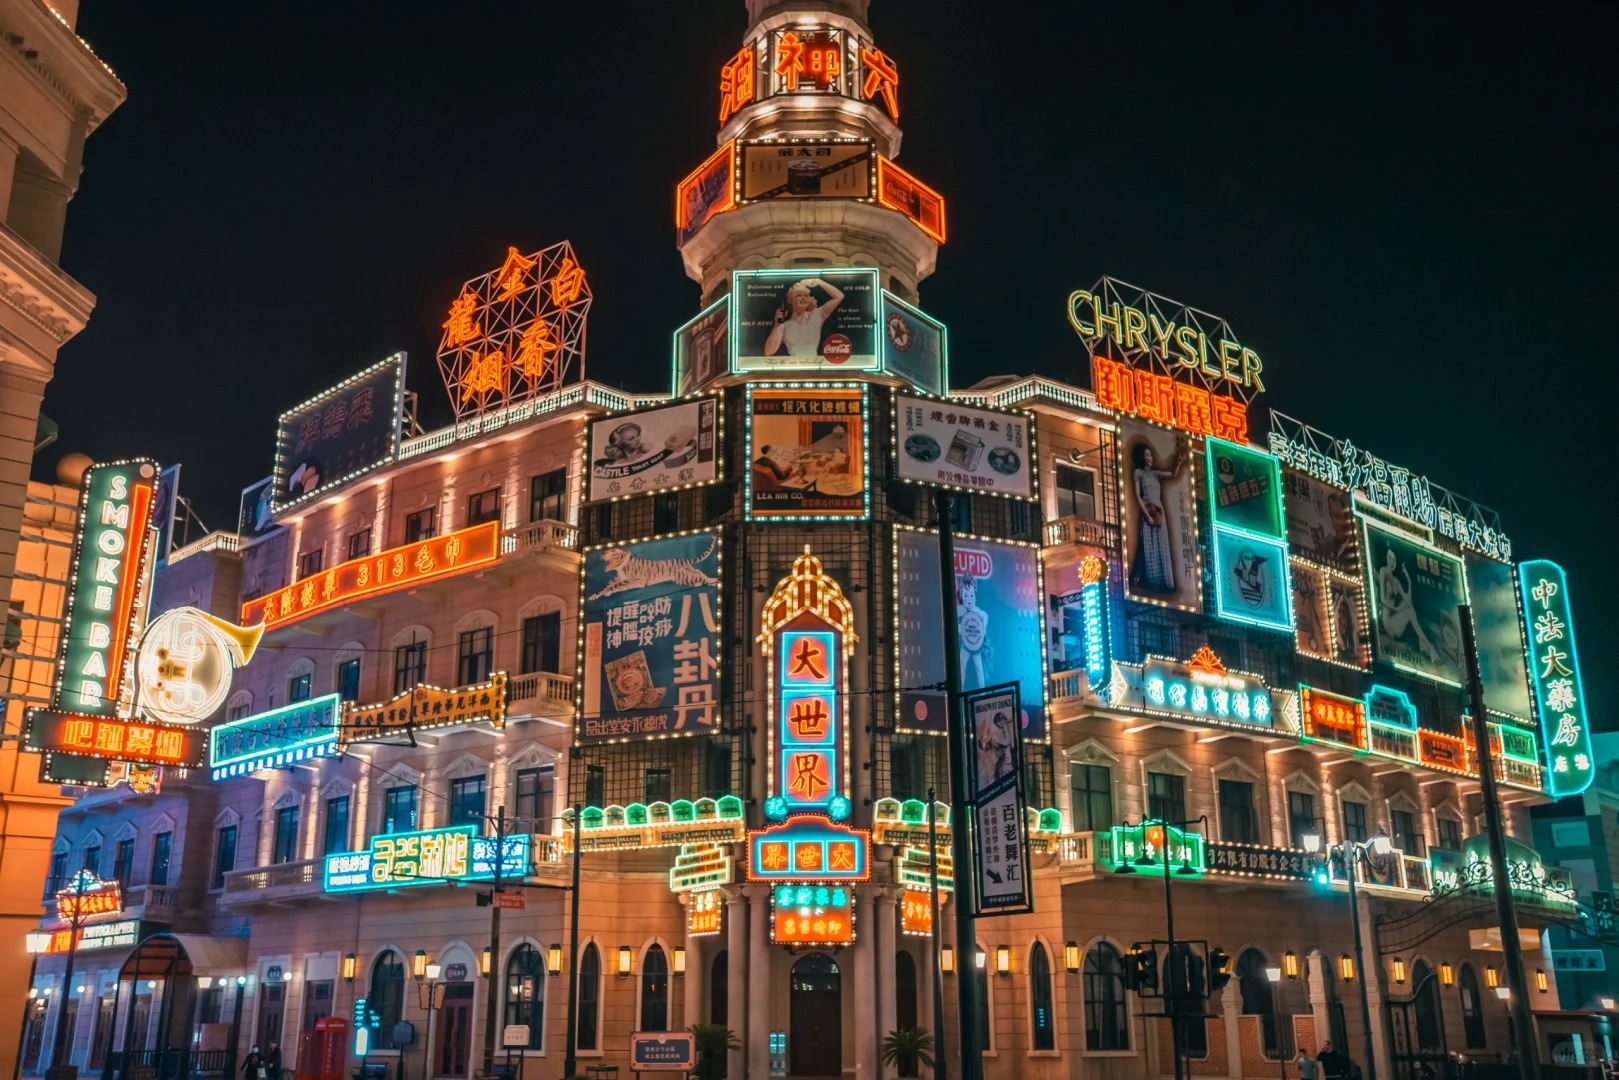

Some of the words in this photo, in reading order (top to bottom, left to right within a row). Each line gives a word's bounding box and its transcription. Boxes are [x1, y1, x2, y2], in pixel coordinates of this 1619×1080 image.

[1067, 290, 1266, 393] CHRYSLER
[593, 464, 630, 479] CASTILE
[631, 459, 650, 472] TOILET
[650, 452, 665, 465] SOAP
[757, 492, 773, 500] LEA
[95, 474, 130, 612] SMOKE
[953, 552, 991, 575] CUPID
[79, 620, 111, 708] BAR
[673, 591, 719, 731] 八卦丹
[1531, 577, 1582, 748] 中法大藥房
[787, 637, 829, 800] 大世界
[763, 843, 853, 871] 大世界
[1001, 802, 1021, 882] 百老舞汇
